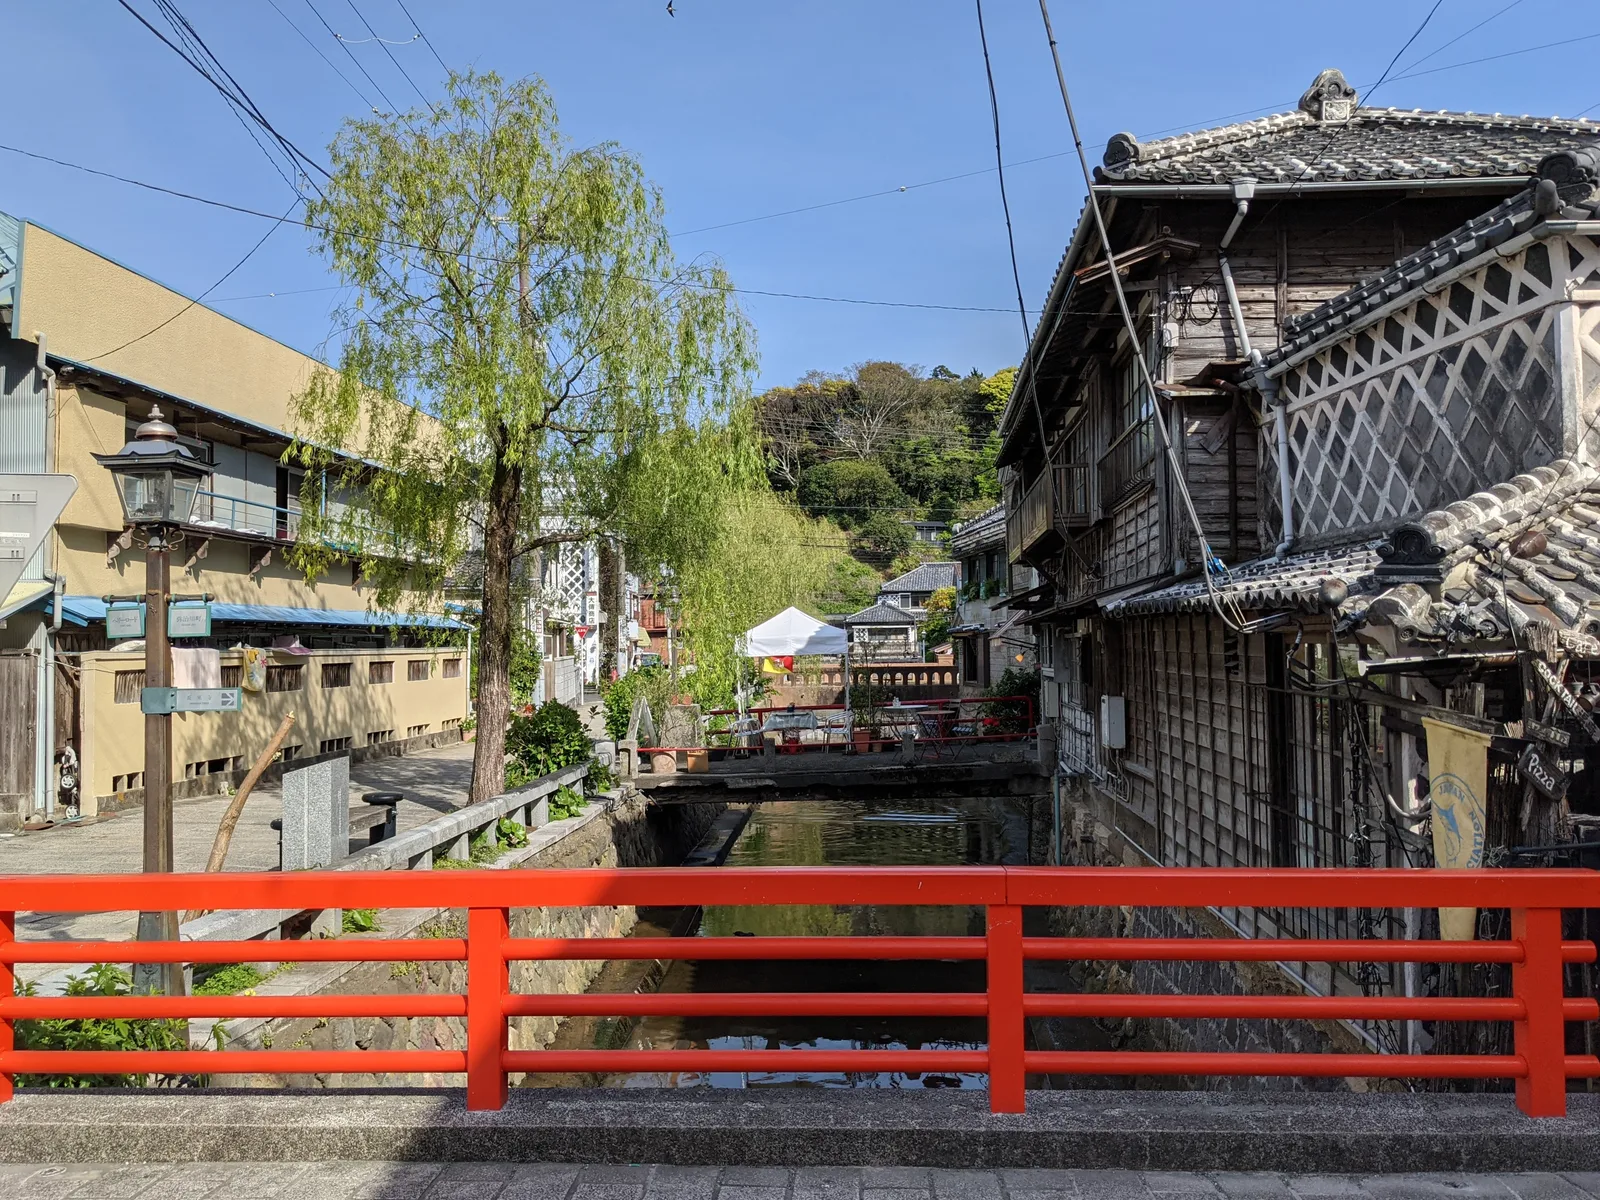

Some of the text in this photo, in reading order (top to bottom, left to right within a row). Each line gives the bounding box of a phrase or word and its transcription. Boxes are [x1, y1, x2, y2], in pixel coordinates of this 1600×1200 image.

[1537, 662, 1579, 714] COCKTAIL
[1528, 753, 1555, 791] Pizza
[1466, 811, 1483, 868] CIATION
